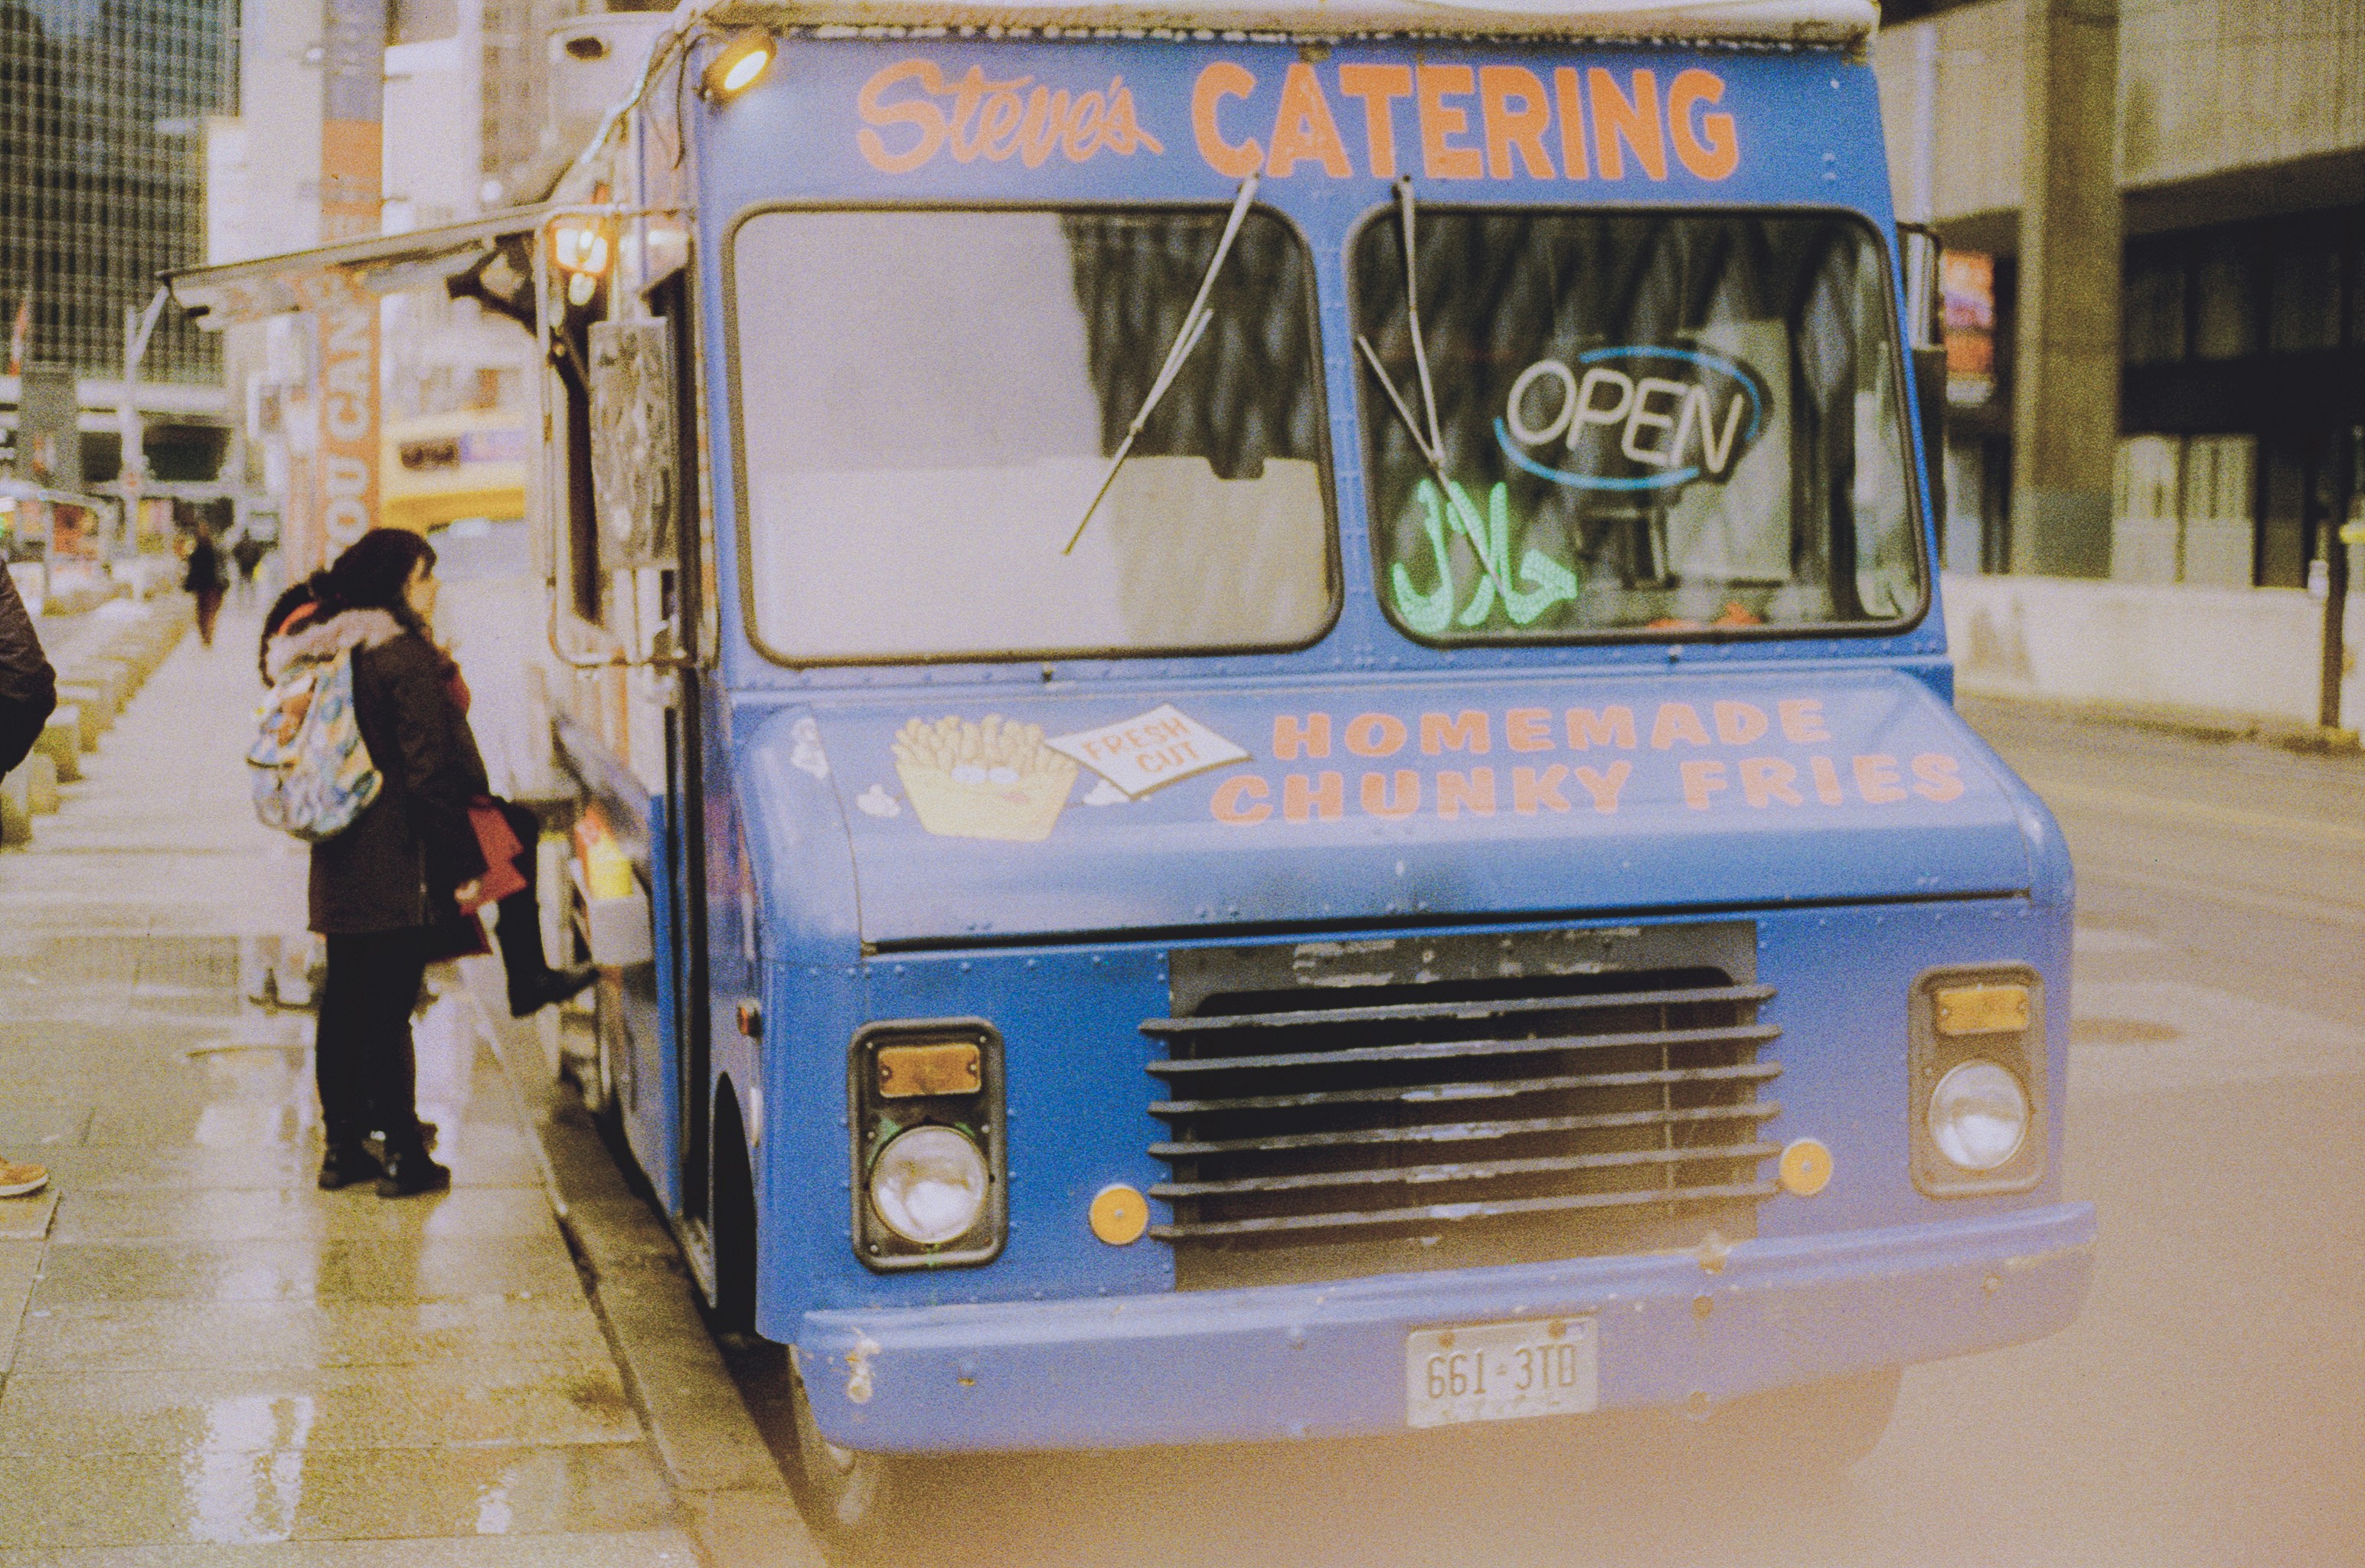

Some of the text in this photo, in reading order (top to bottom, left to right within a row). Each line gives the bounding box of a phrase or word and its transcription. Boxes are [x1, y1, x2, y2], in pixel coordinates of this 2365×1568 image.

[857, 58, 1739, 182] Steve's CATERING
[1506, 358, 1745, 474] OPEN
[1080, 715, 1191, 761] FRESH
[1135, 740, 1200, 773] CUT
[1272, 699, 1831, 760] HOMEMADE
[1210, 753, 1965, 825] CHUNKY FRIES
